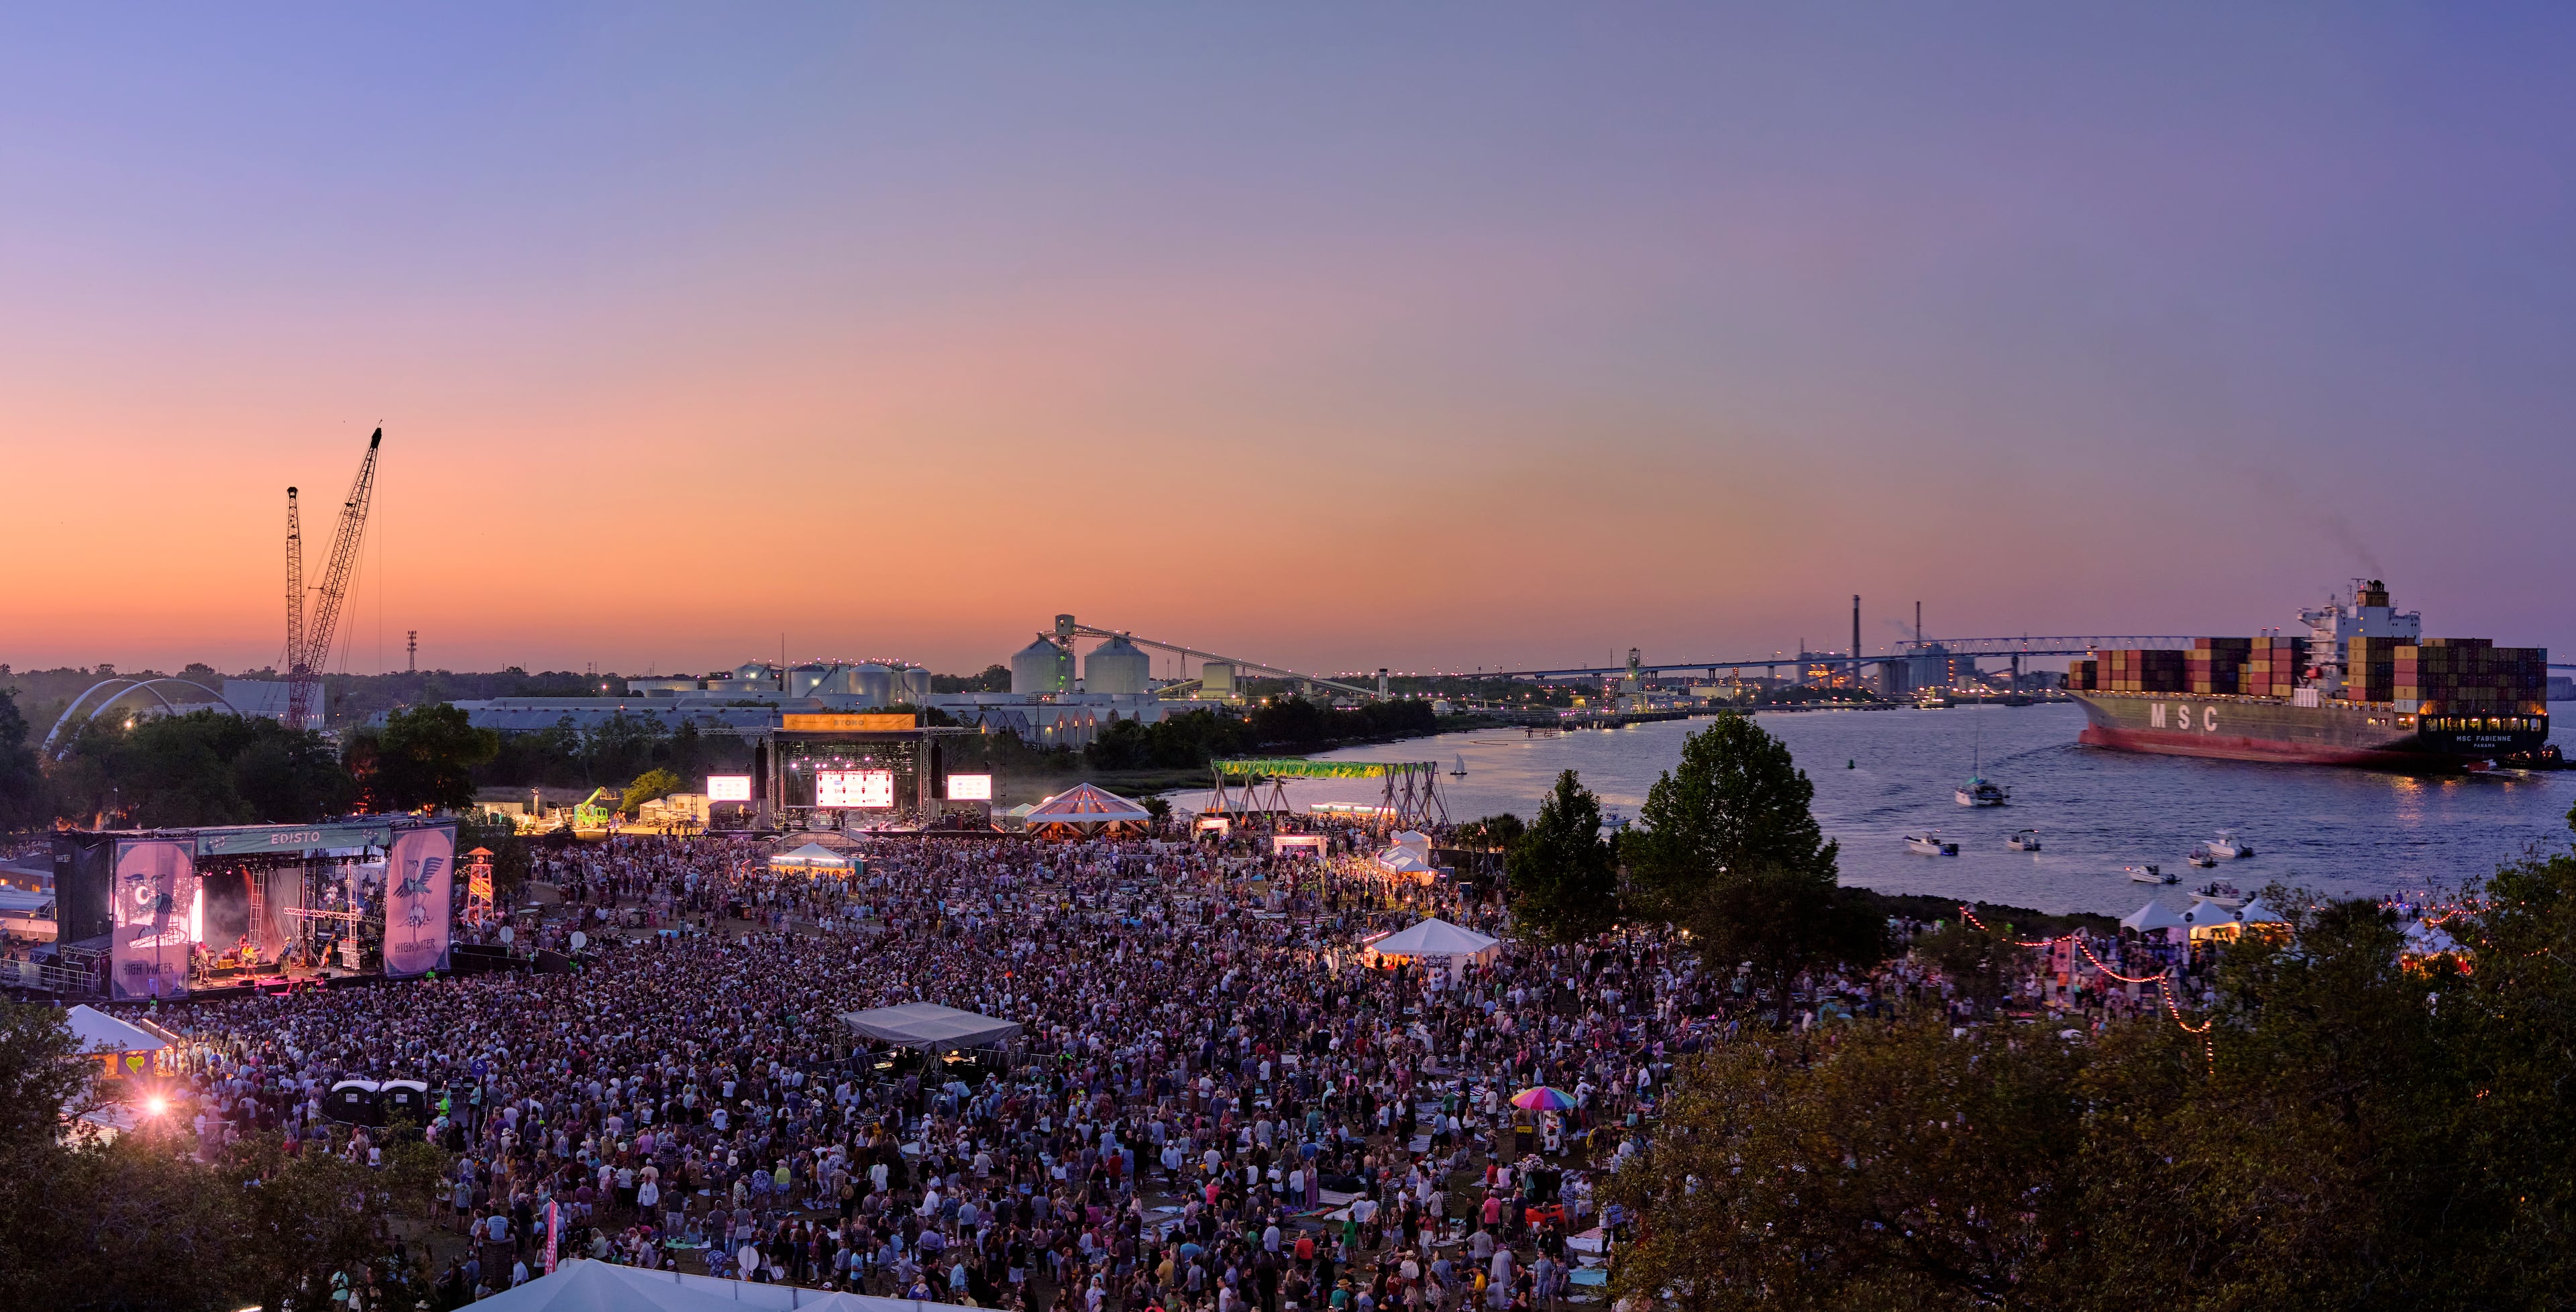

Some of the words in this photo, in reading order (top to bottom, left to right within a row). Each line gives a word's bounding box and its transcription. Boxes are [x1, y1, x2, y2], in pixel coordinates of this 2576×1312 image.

[271, 832, 320, 844] EDISTO
[395, 942, 414, 953] HIGH
[123, 963, 142, 975] HIGH
[146, 963, 174, 974] WATER
